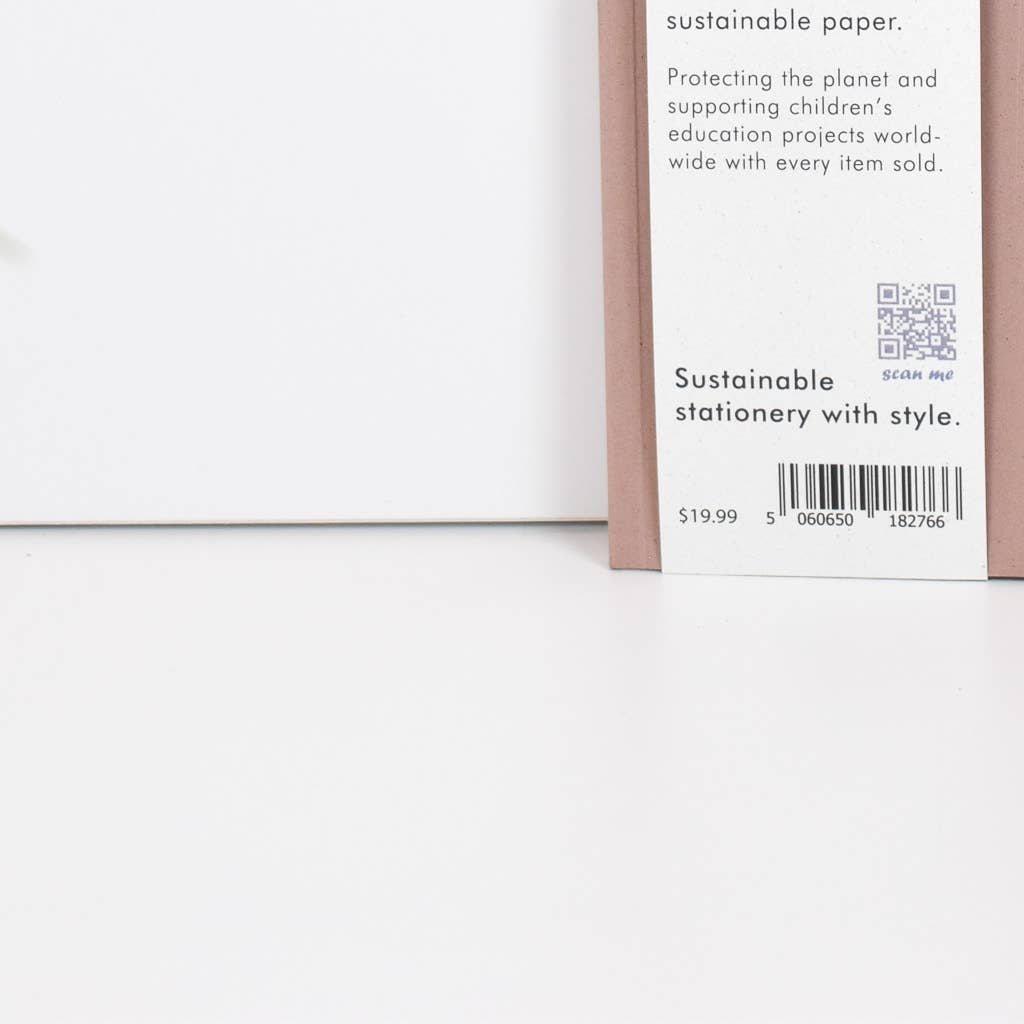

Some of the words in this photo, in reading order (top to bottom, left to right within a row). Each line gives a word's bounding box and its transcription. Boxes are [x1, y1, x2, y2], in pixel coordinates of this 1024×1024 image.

[666, 7, 811, 31] sustainable
[823, 16, 902, 37] paper.
[668, 67, 772, 92] Protecting
[781, 67, 814, 88] the
[823, 67, 889, 92] planet
[897, 68, 937, 88] and
[667, 97, 779, 120] supporting
[789, 95, 893, 116] children's
[668, 122, 772, 143] education
[782, 126, 865, 148] projects
[873, 123, 941, 145] world-
[668, 150, 717, 170] wide
[724, 151, 767, 171] with
[776, 158, 831, 176] every
[840, 154, 883, 172] item
[893, 152, 943, 173] sold.
[674, 366, 834, 392] Sustainable
[881, 368, 923, 382] scan
[928, 369, 955, 382] me
[675, 400, 812, 429] stationery
[821, 401, 878, 425] with
[890, 403, 961, 432] style.
[678, 506, 738, 525] $19.99
[766, 511, 776, 525] 5
[797, 511, 854, 527] 060650
[889, 513, 946, 529] 182766
